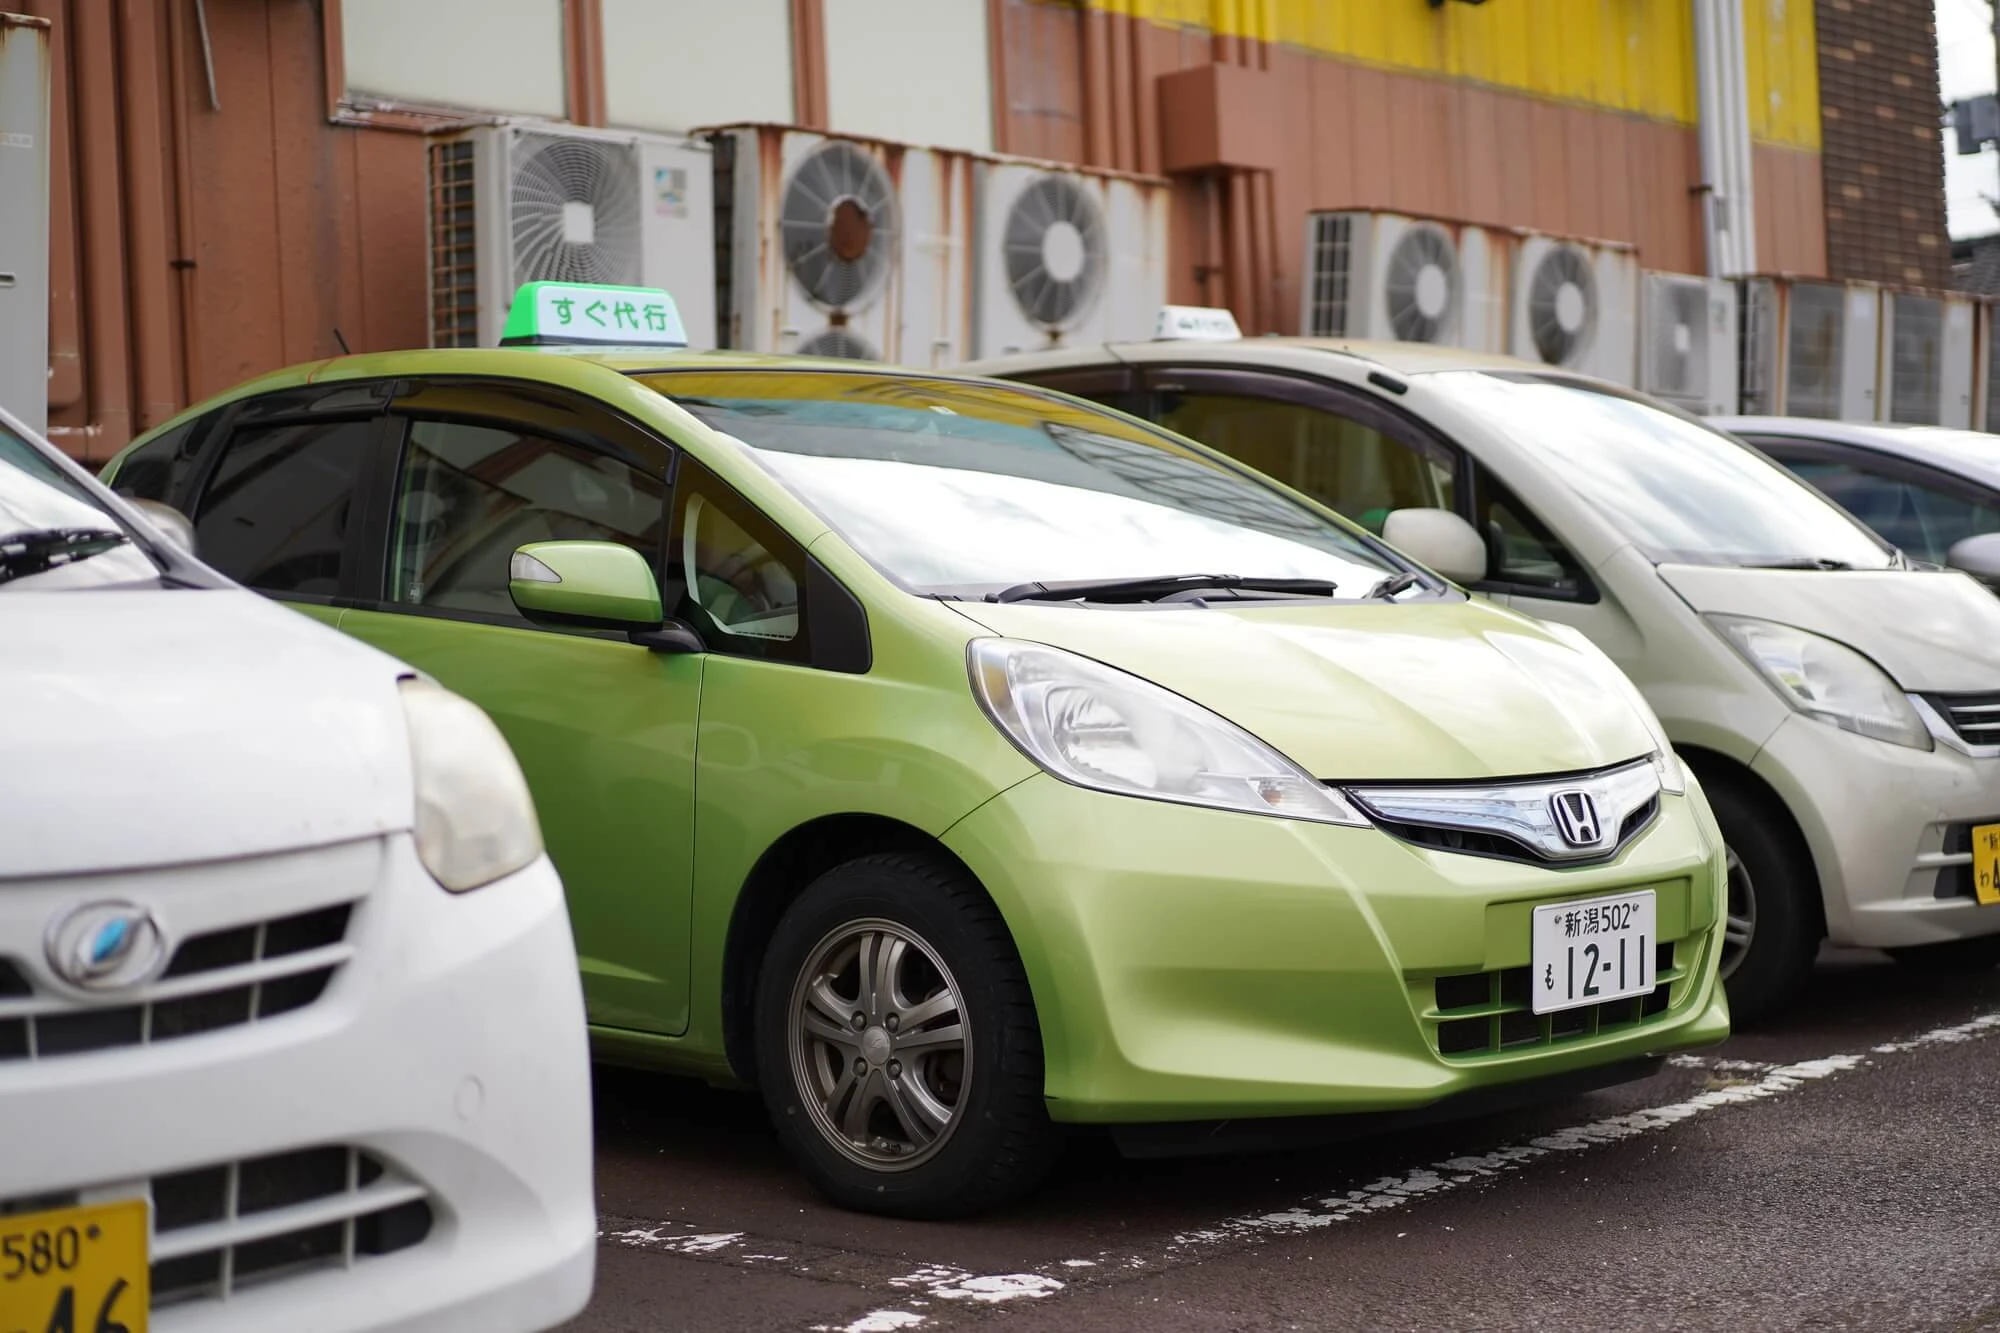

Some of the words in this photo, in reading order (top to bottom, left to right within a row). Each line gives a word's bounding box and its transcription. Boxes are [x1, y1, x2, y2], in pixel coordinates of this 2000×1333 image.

[551, 297, 667, 331] すぐ代行
[1565, 903, 1631, 938] 新潟502
[1545, 963, 1554, 990] も
[1568, 935, 1645, 1000] 12-11
[2, 1225, 79, 1282] 580
